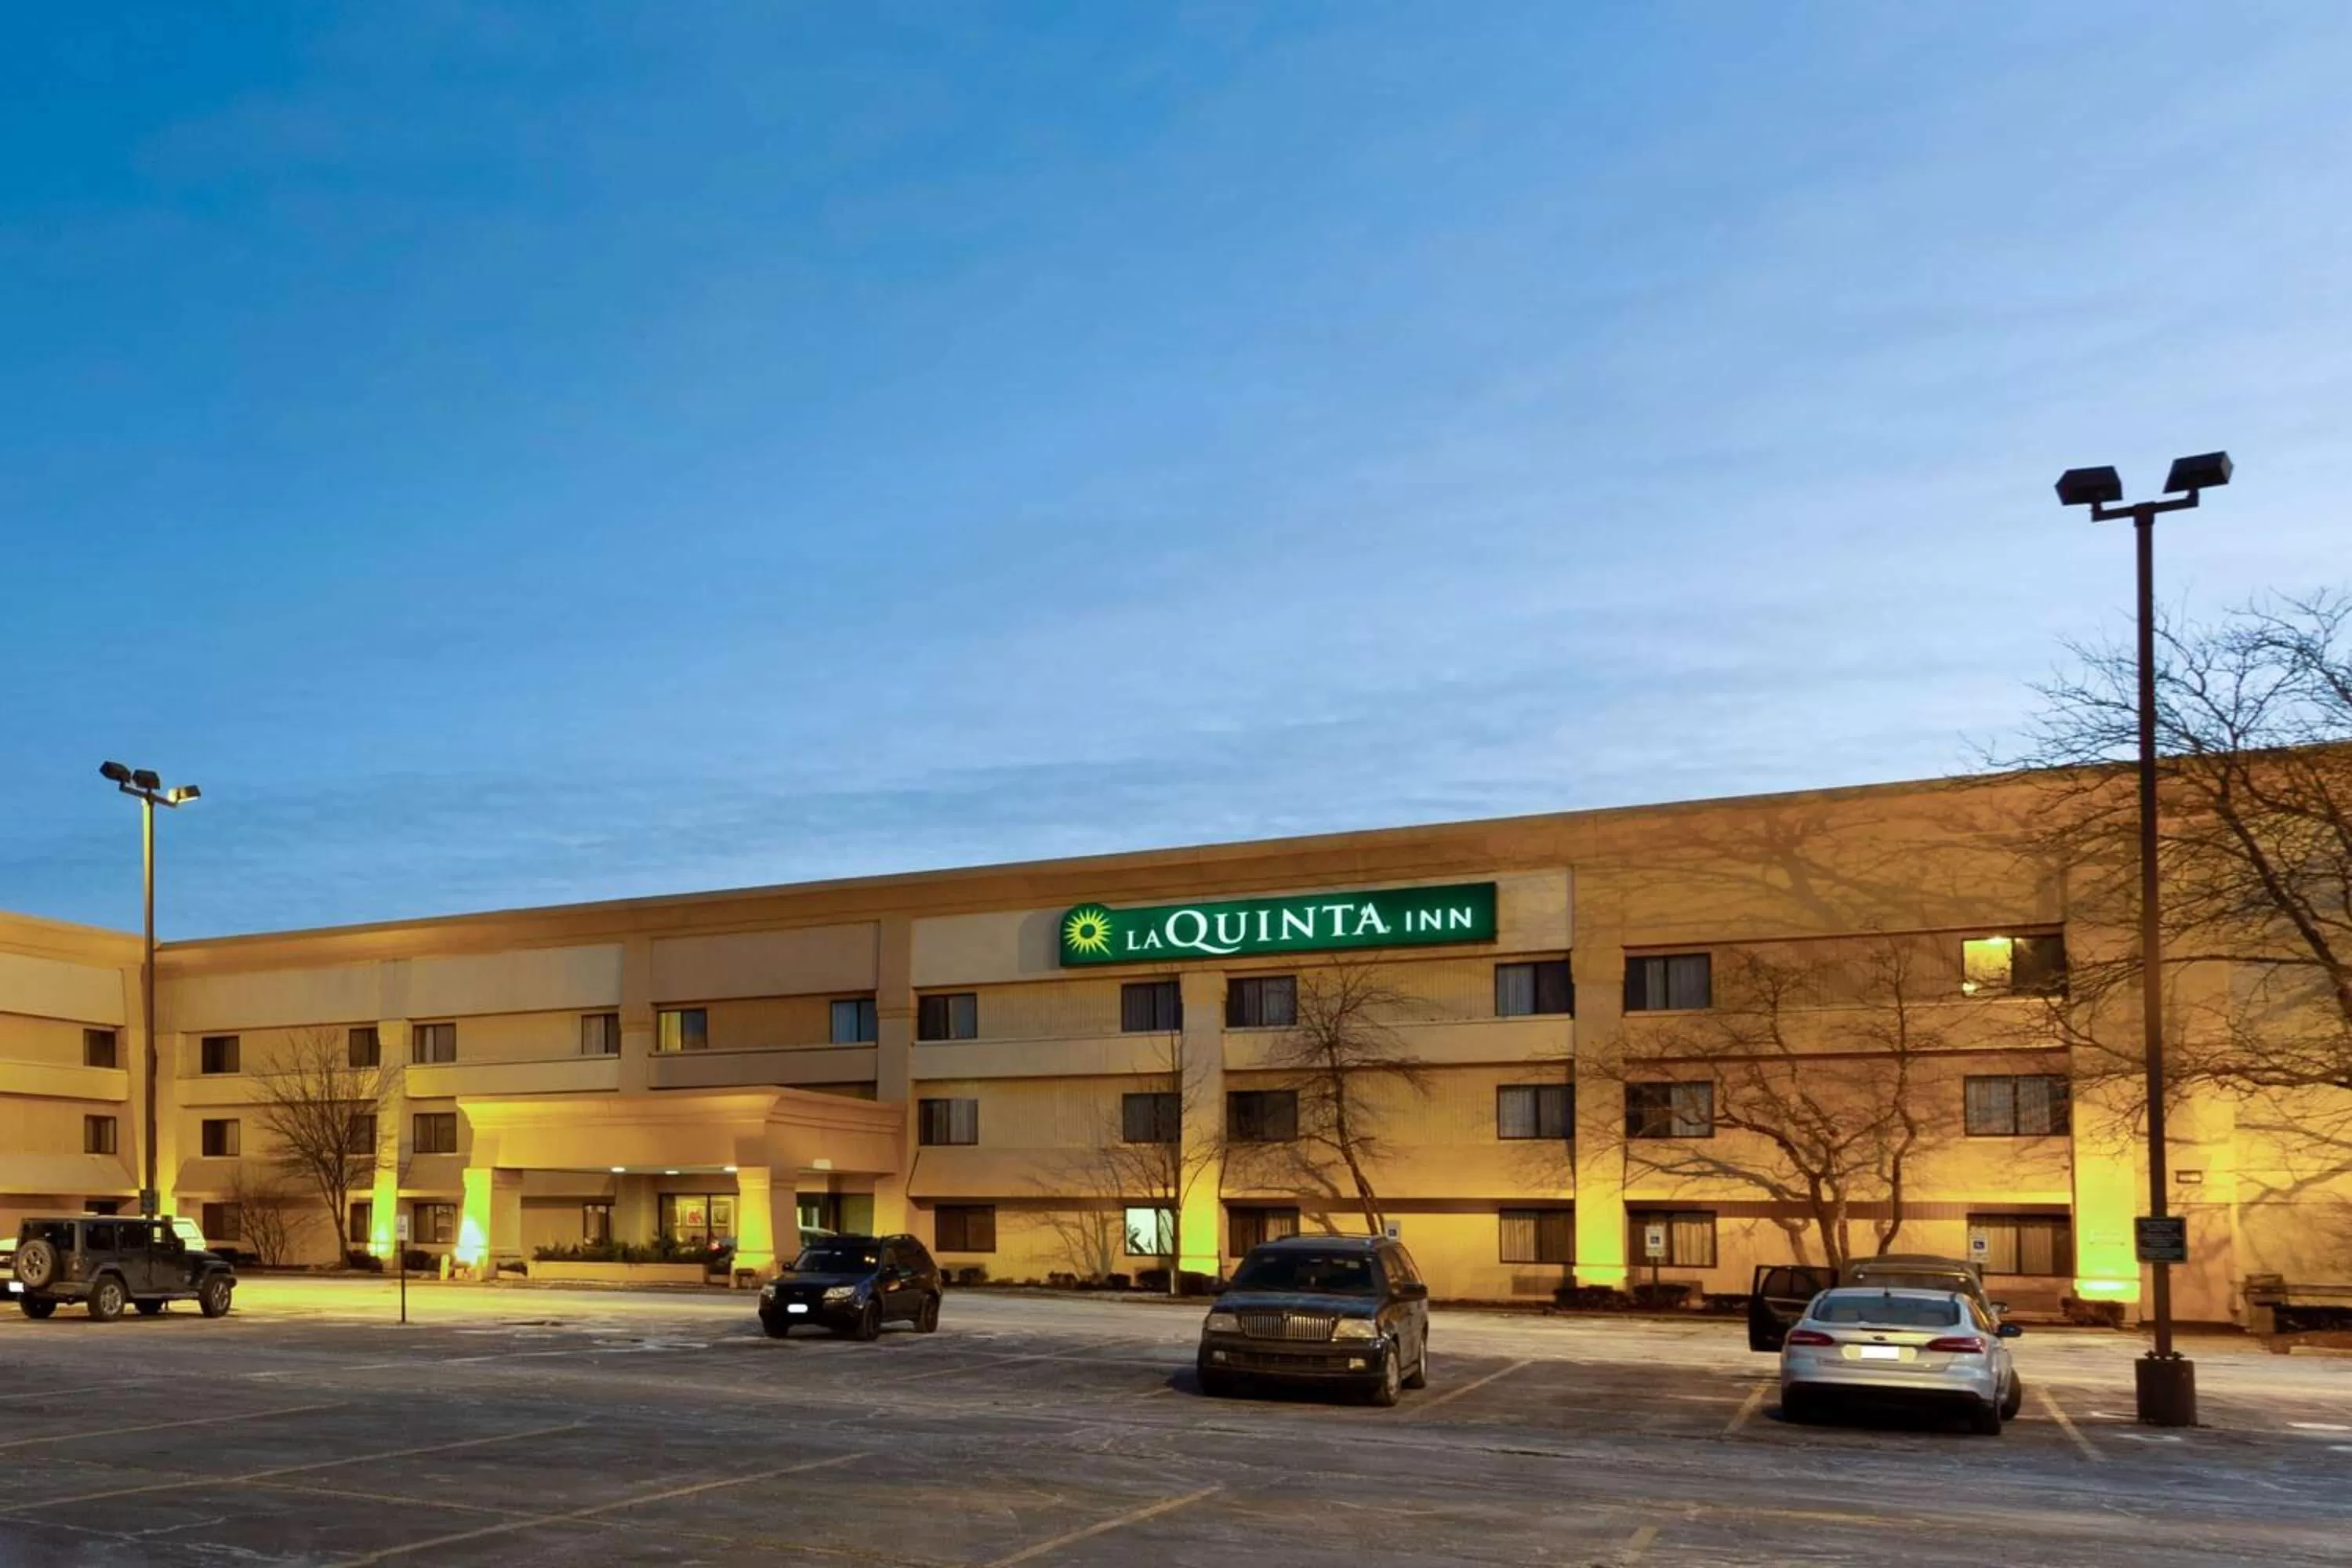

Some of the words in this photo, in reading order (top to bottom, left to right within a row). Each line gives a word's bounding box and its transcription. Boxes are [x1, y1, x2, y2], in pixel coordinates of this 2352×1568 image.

[1127, 929, 1163, 950] LA
[1165, 902, 1391, 954] QUINTA
[1405, 907, 1472, 932] INN
